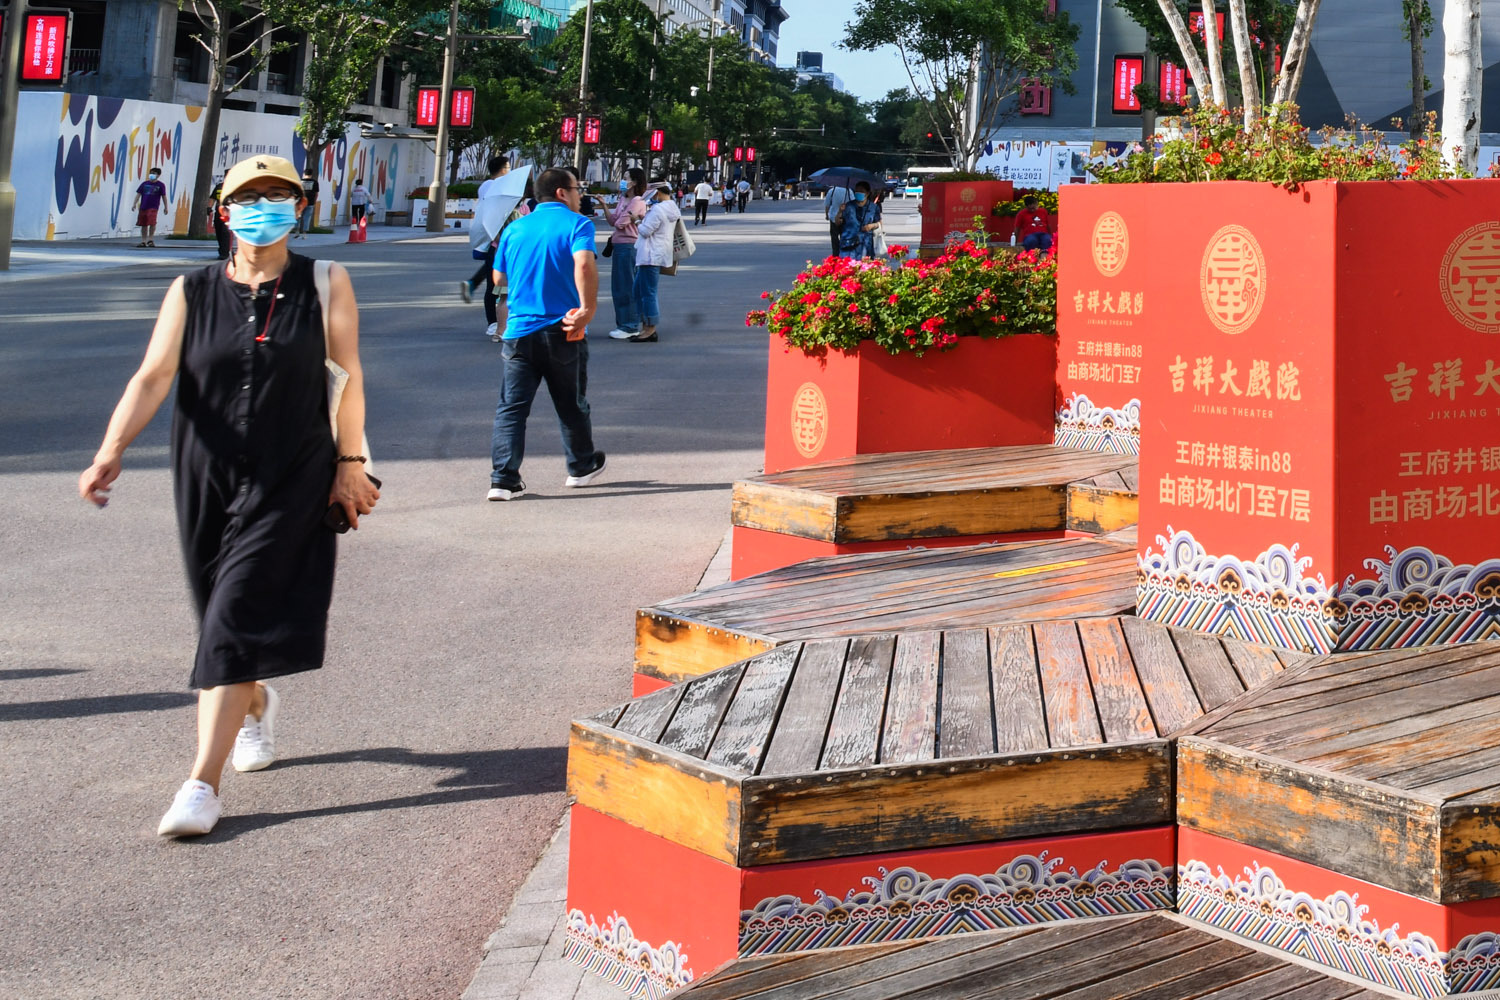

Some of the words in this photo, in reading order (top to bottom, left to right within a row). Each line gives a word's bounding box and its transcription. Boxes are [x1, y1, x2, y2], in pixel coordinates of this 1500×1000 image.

[1077, 341, 1142, 358] 王府井银泰in88
[1067, 361, 1141, 384] 由商场北门至7
[1192, 404, 1228, 415] JIXIANG
[1232, 407, 1273, 419] THEATER
[1428, 408, 1488, 420] JIXIANG
[1175, 440, 1292, 474] 王府井银泰in88
[1158, 473, 1311, 522] 由商场北门至7层
